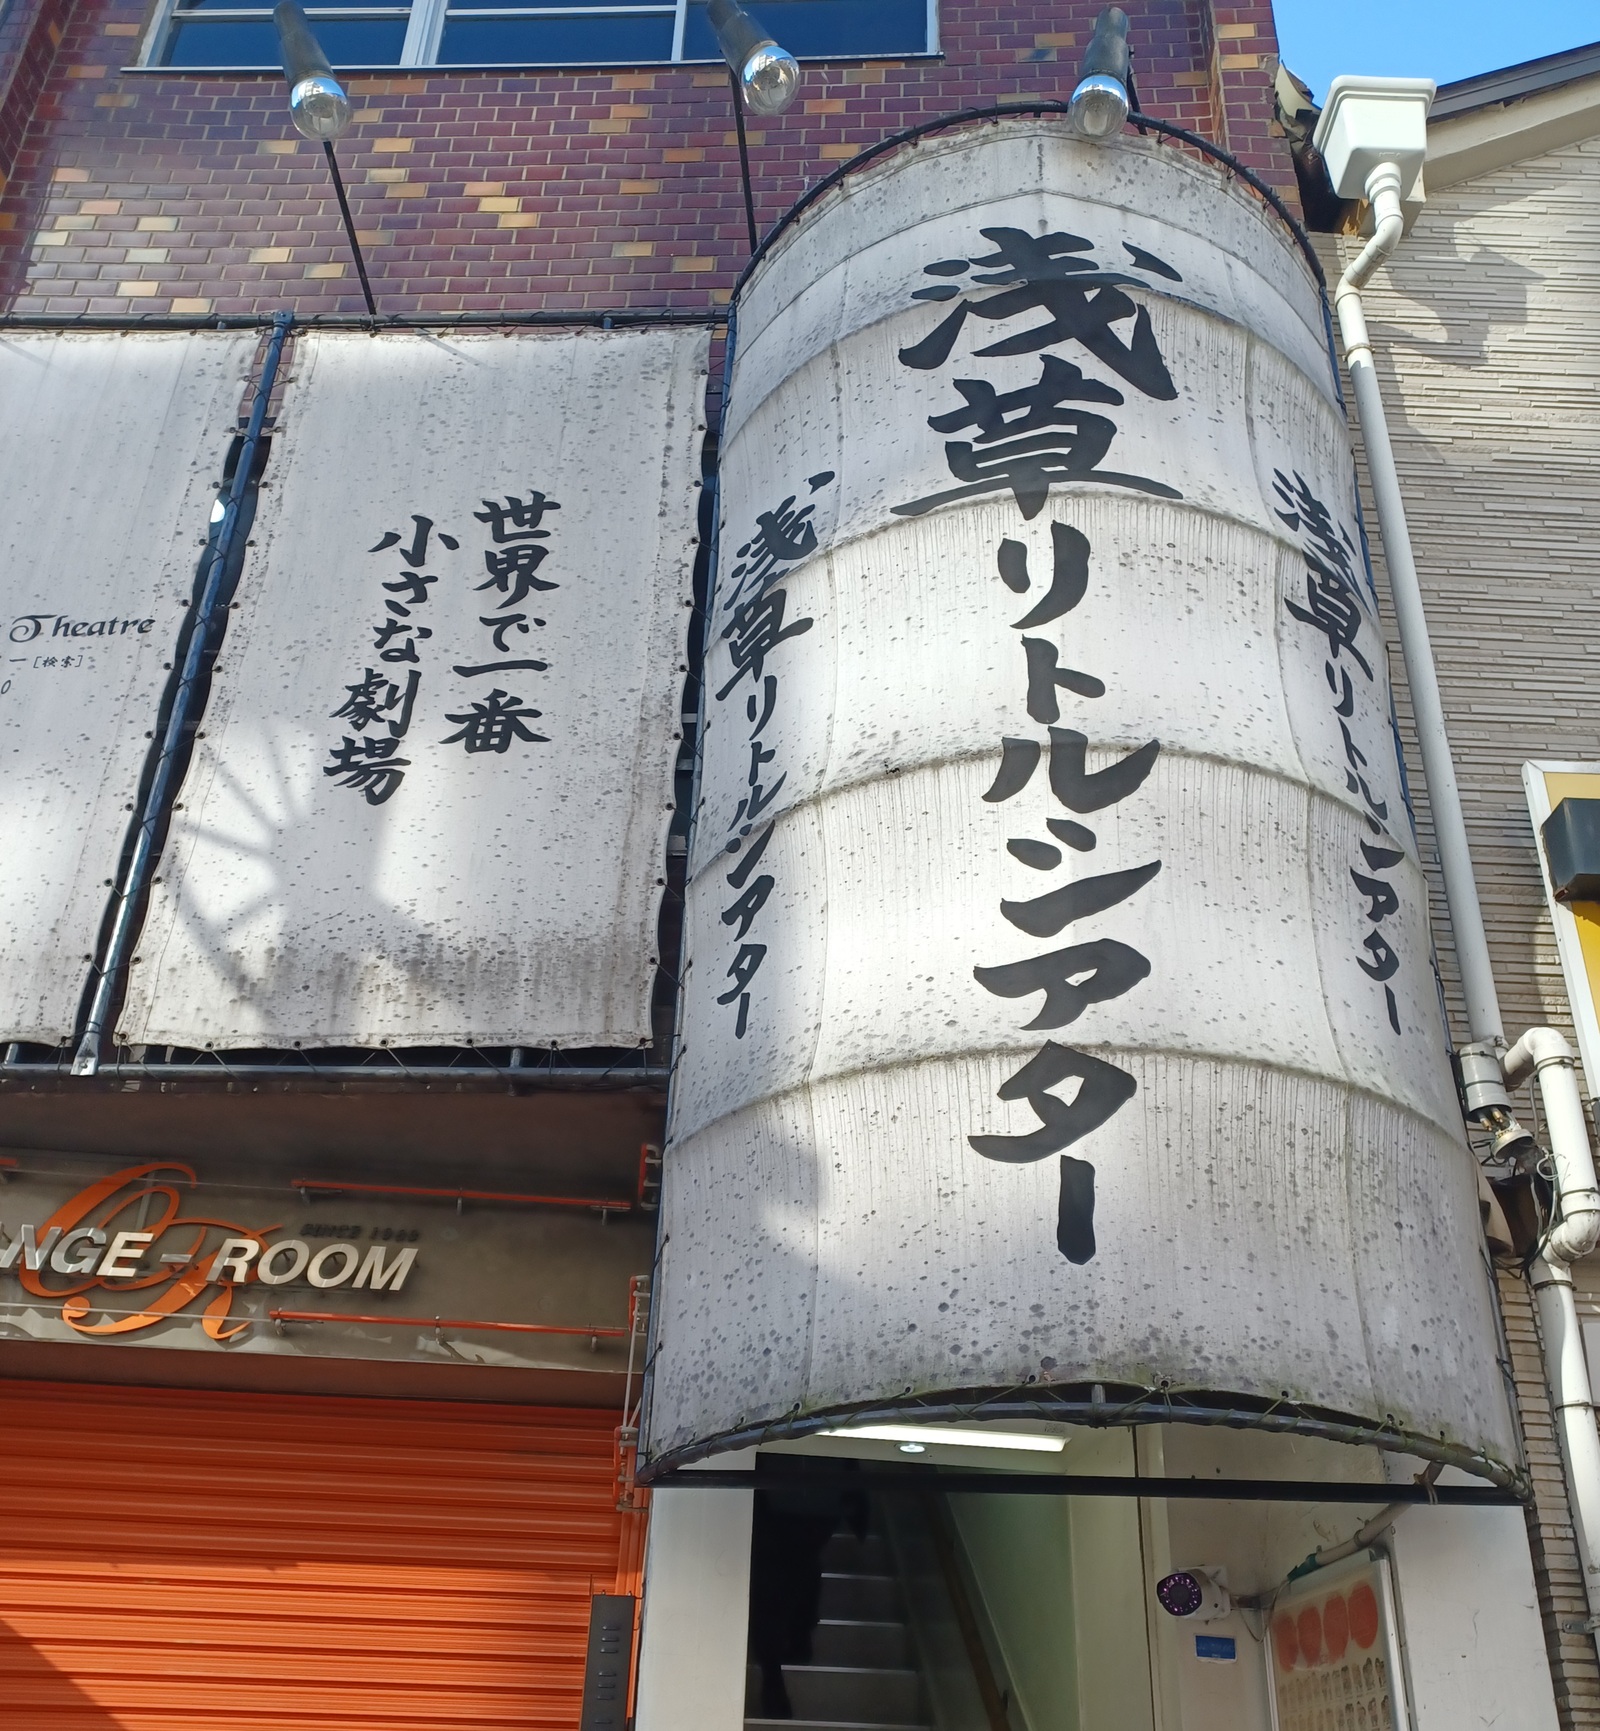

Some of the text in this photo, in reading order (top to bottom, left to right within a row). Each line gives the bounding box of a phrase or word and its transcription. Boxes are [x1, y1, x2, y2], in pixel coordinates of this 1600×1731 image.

[9, 614, 156, 643] Theatre
[323, 514, 460, 806] 小さな劇場
[438, 490, 561, 754] 世界で一番
[716, 471, 835, 1039] 浅草リトルシアター
[890, 227, 1183, 1265] 浅草リトルシアター
[0, 1224, 154, 1276] NGE
